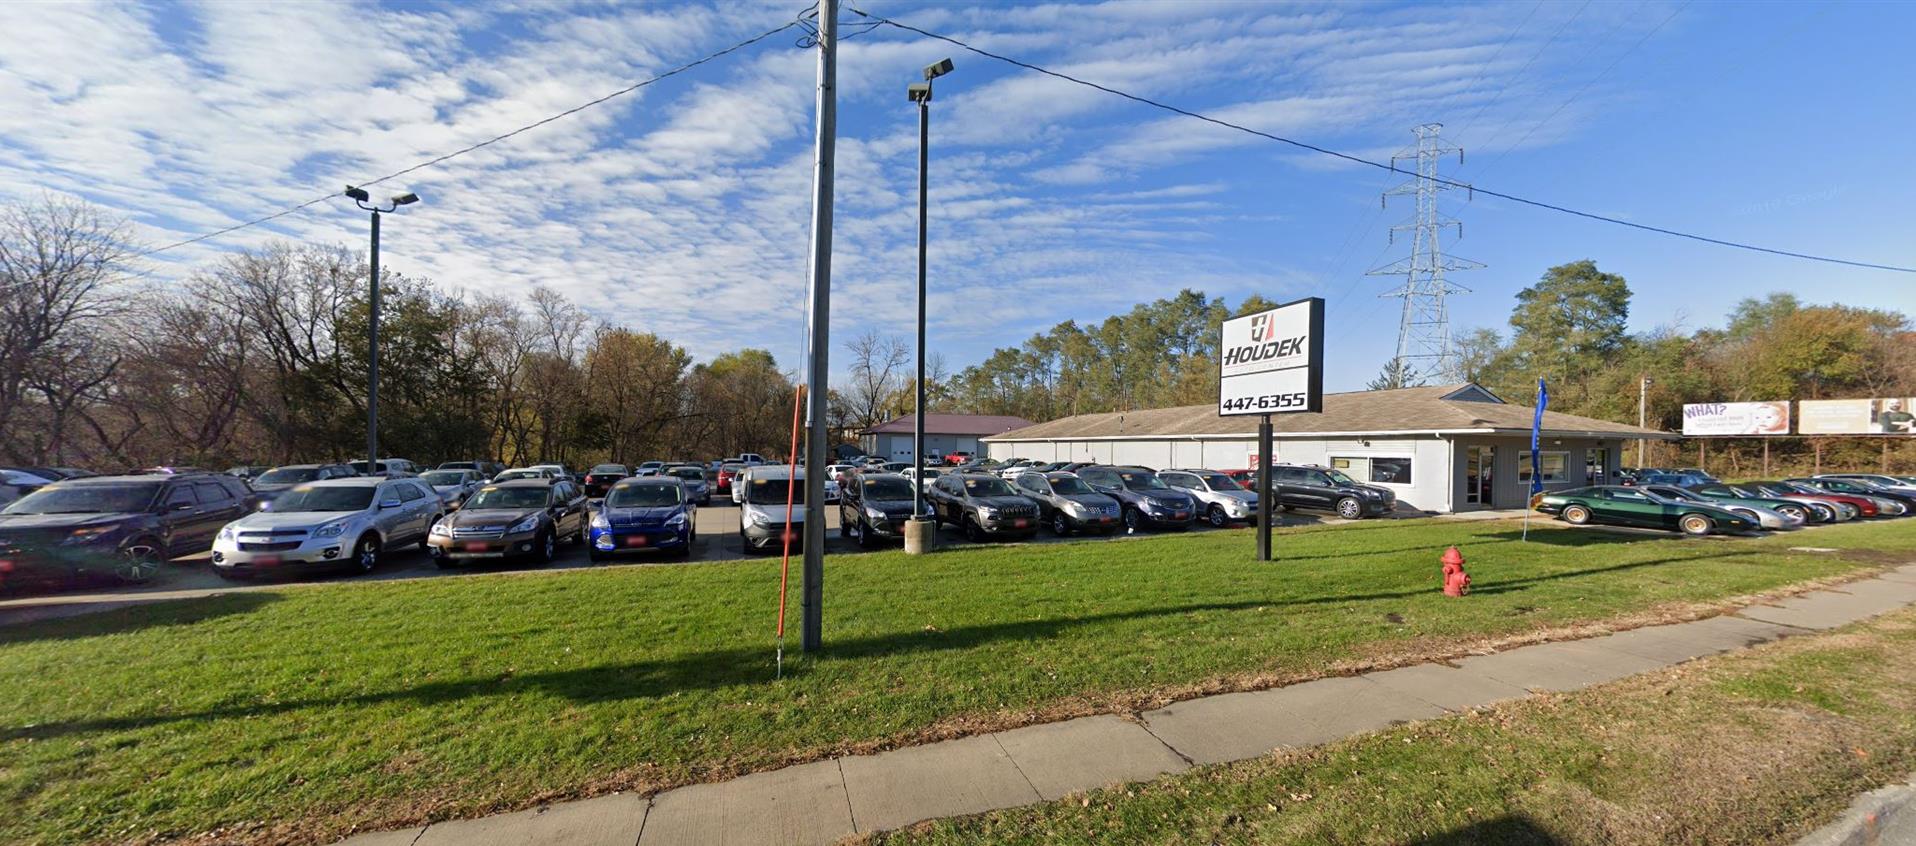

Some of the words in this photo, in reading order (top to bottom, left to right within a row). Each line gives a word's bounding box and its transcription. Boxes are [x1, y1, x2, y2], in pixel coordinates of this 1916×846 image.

[1224, 335, 1307, 366] HOUDEK
[1222, 392, 1306, 411] 447-6355
[1684, 403, 1727, 419] WHAT?
